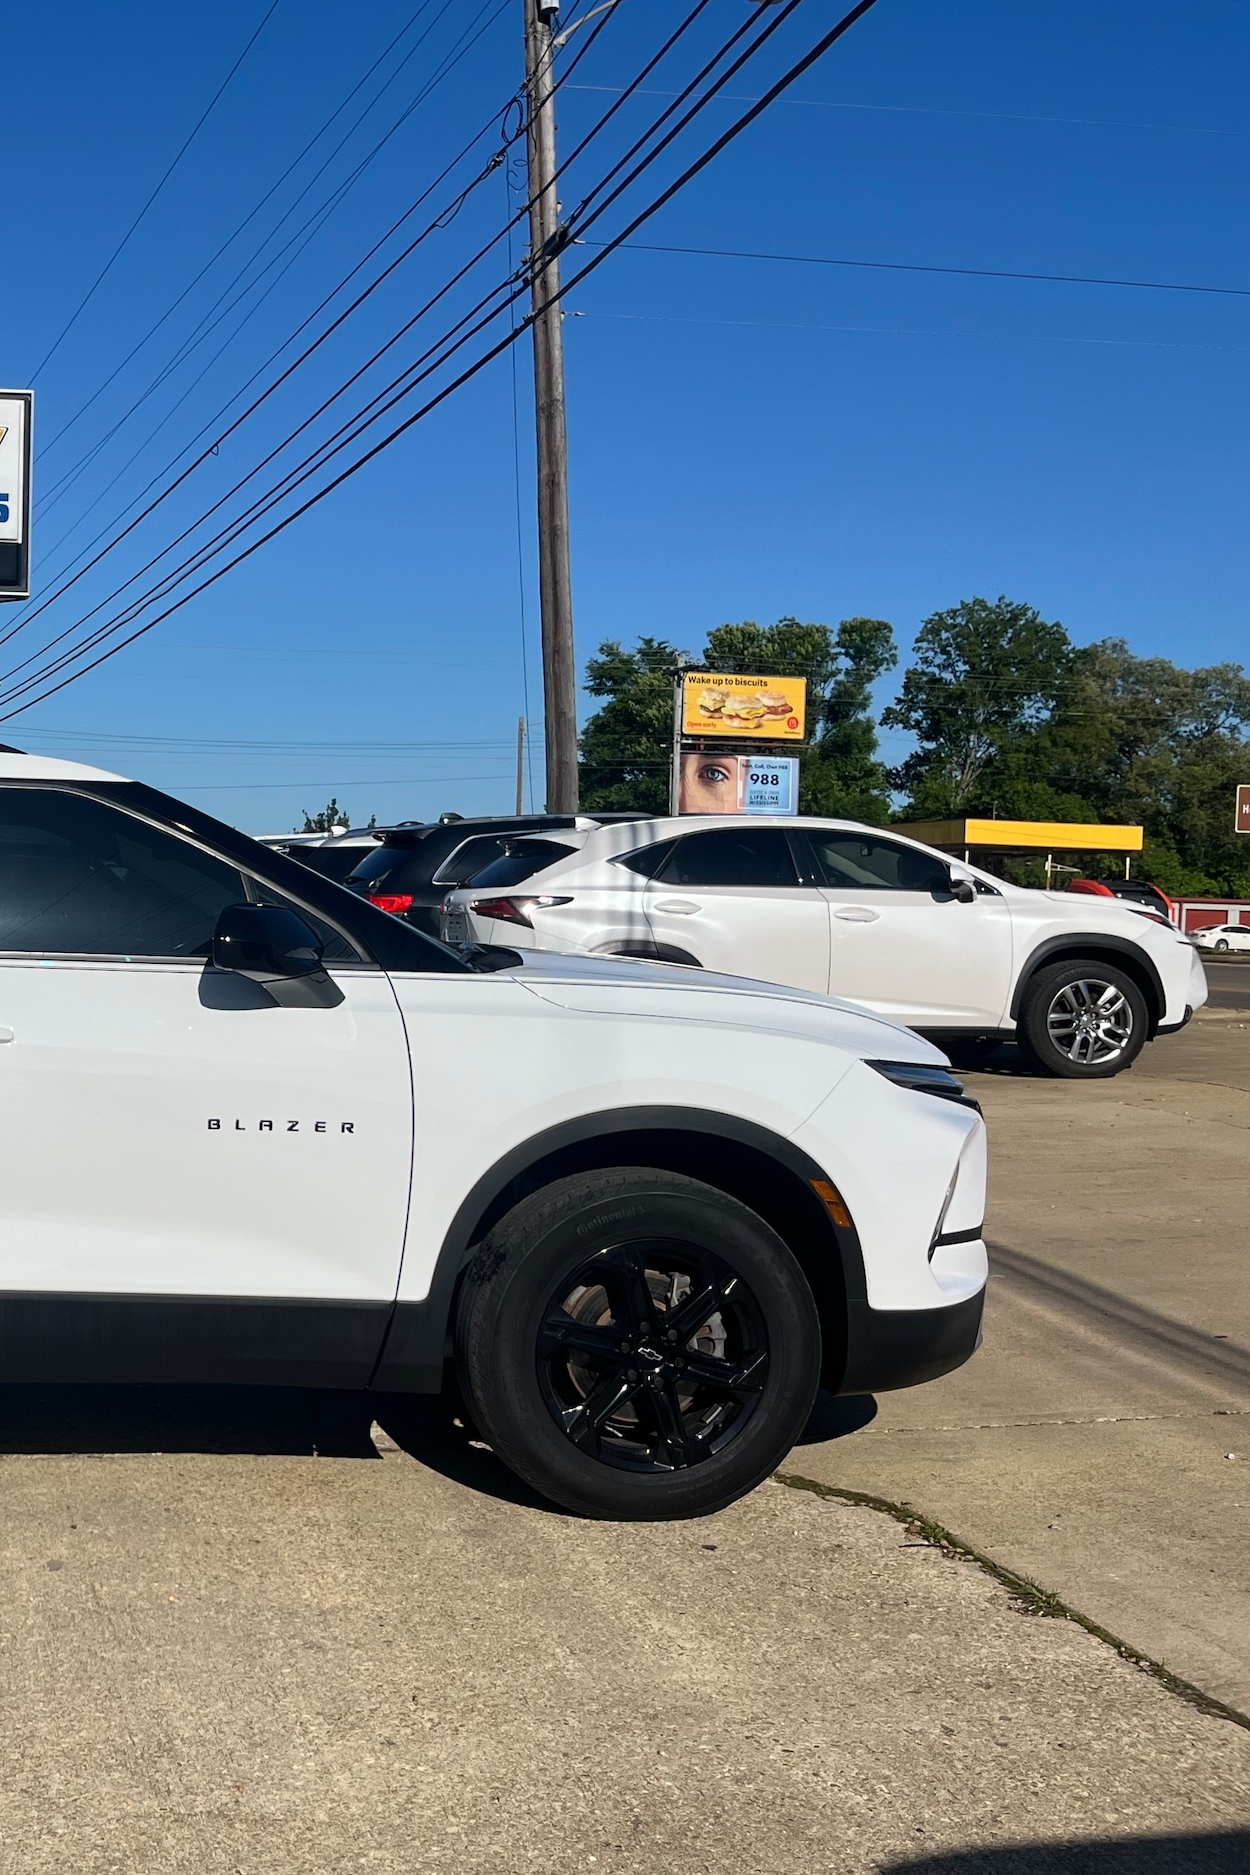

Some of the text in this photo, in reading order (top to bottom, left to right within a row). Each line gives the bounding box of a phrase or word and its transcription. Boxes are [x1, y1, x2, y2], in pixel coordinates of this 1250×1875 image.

[688, 676, 768, 687] Wake up to biscuits
[750, 773, 779, 786] 988
[207, 1118, 355, 1134] BLAZER
